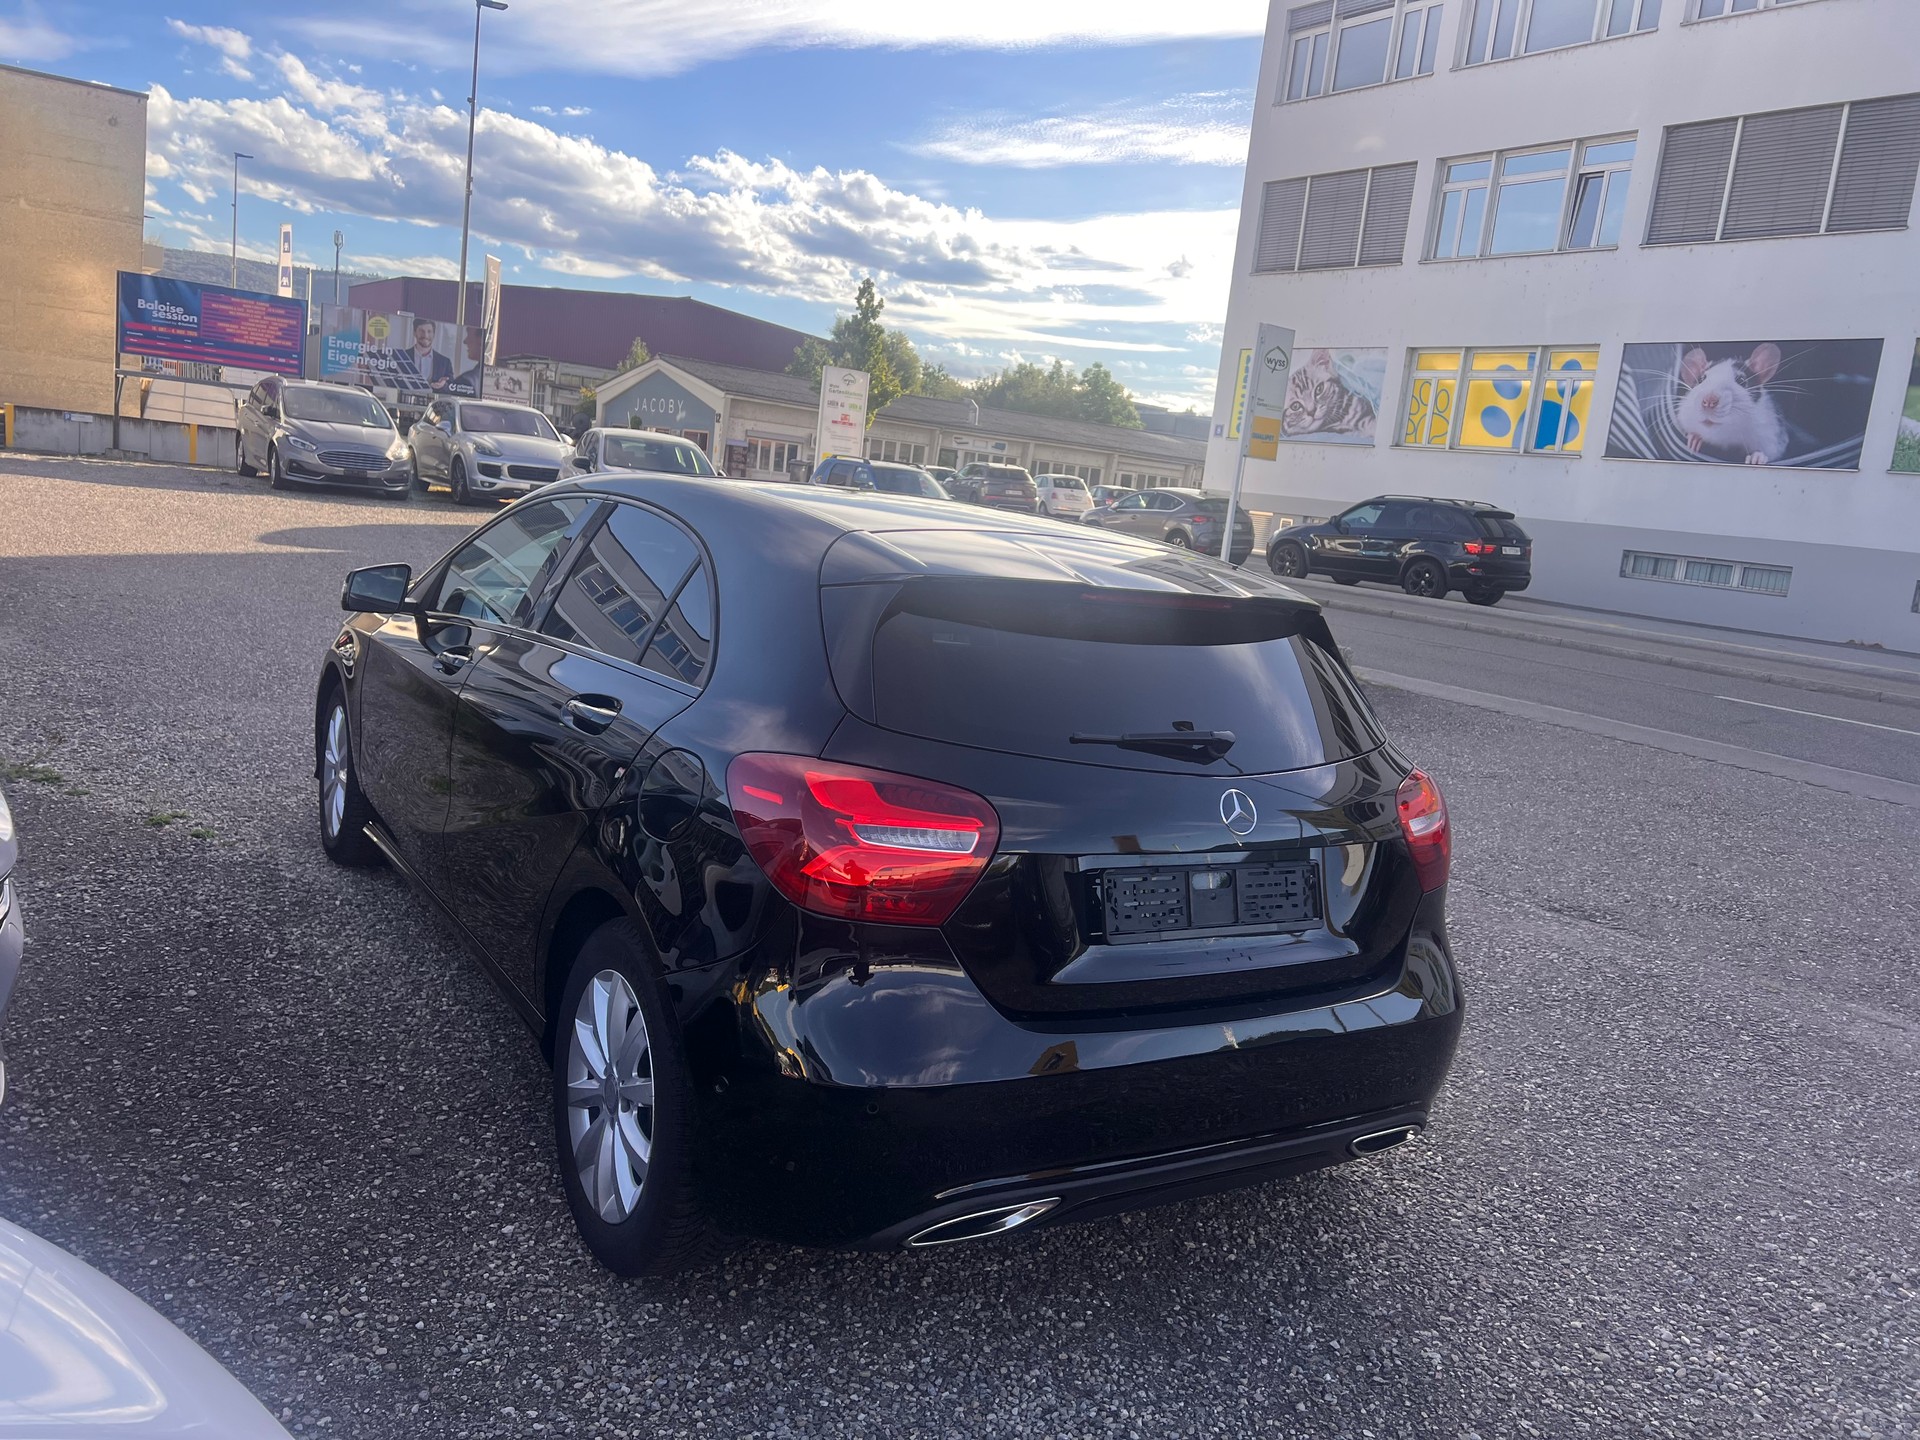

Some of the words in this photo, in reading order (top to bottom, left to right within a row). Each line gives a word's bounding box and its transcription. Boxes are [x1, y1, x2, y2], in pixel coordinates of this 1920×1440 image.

[137, 298, 184, 314] Baloise
[151, 310, 198, 323] session
[328, 336, 377, 354] Energie
[381, 343, 393, 355] in
[327, 349, 397, 370] Eigenregie
[1266, 357, 1286, 374] wyss
[634, 397, 684, 414] JACOBY
[715, 412, 721, 424] 12
